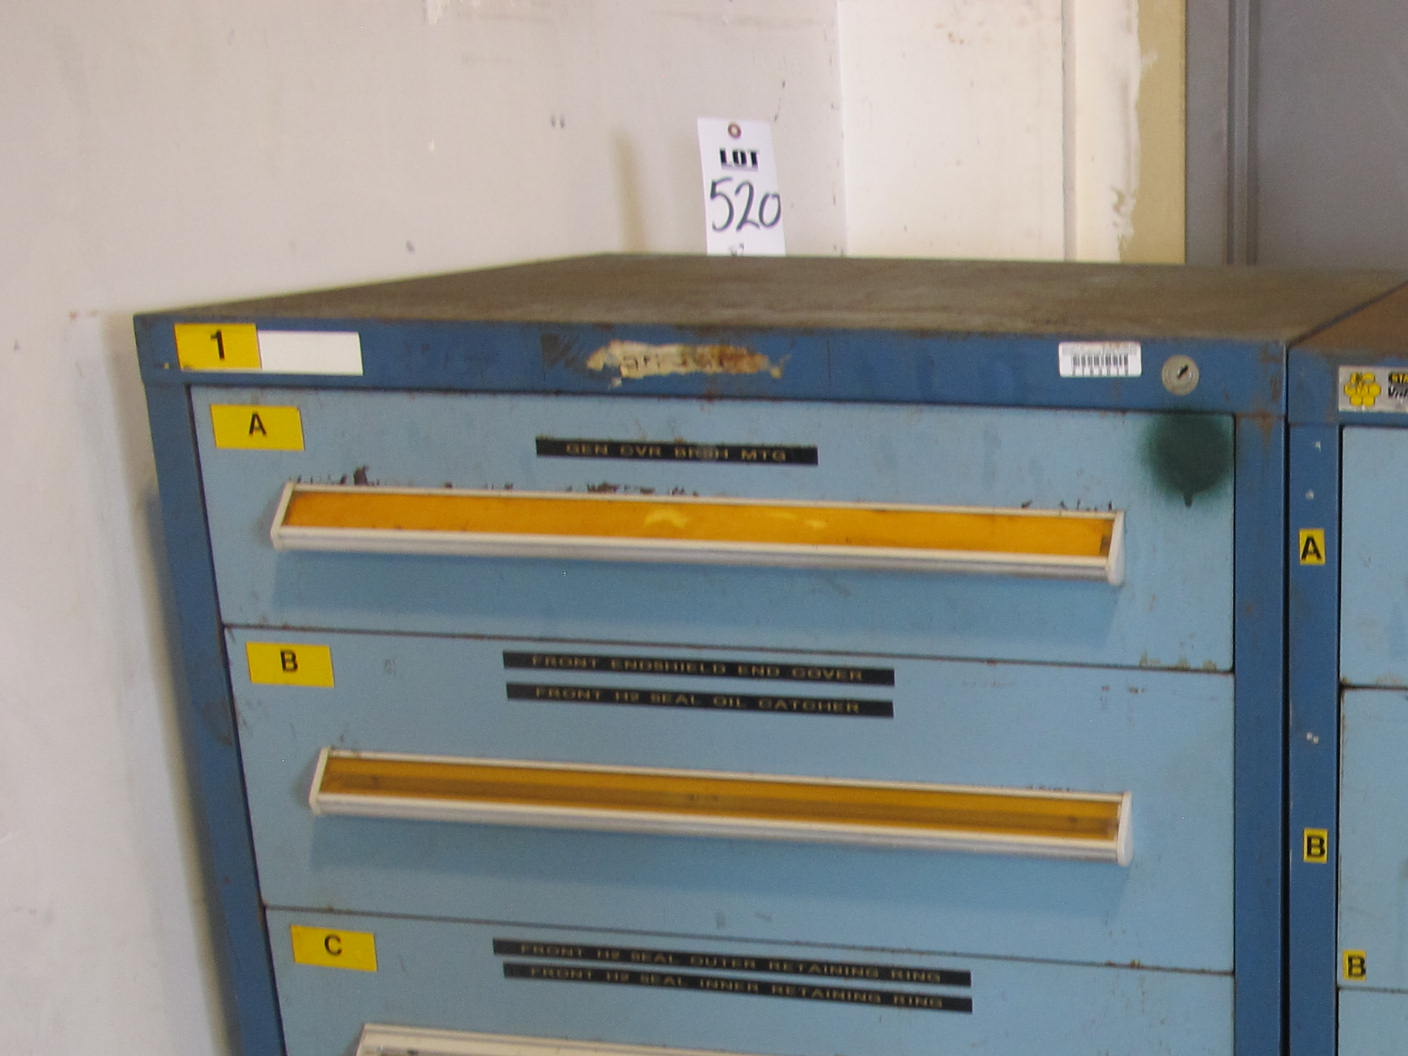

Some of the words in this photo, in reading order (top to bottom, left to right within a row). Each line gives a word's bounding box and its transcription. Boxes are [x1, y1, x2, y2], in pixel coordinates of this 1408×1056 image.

[720, 148, 758, 169] LOT
[709, 176, 782, 232] 520
[210, 329, 226, 360] 1
[247, 412, 267, 436] A
[565, 444, 608, 456] GEN
[740, 449, 787, 462] MTG
[1302, 535, 1323, 561] A
[279, 649, 299, 672] B
[531, 656, 599, 669] FRONT
[610, 659, 727, 675] ENDSHIELD
[737, 664, 781, 677] END
[791, 667, 863, 681] COVER
[534, 687, 601, 701] FRONT
[650, 692, 698, 705] SEAL
[713, 695, 743, 707] OIL
[758, 697, 861, 713] CATCHER
[1306, 836, 1326, 857] B
[323, 934, 342, 956] C
[520, 944, 584, 959] FRONT
[629, 951, 676, 965] SEAL
[689, 955, 757, 970] OUTER
[768, 960, 879, 978] RETAINING
[890, 967, 942, 982] RING
[1347, 956, 1366, 977] B
[530, 968, 594, 982] FRONT
[639, 975, 686, 989] SEAL
[699, 979, 760, 994] INNER
[771, 984, 883, 1003] RETAINING
[892, 992, 944, 1008] RING
